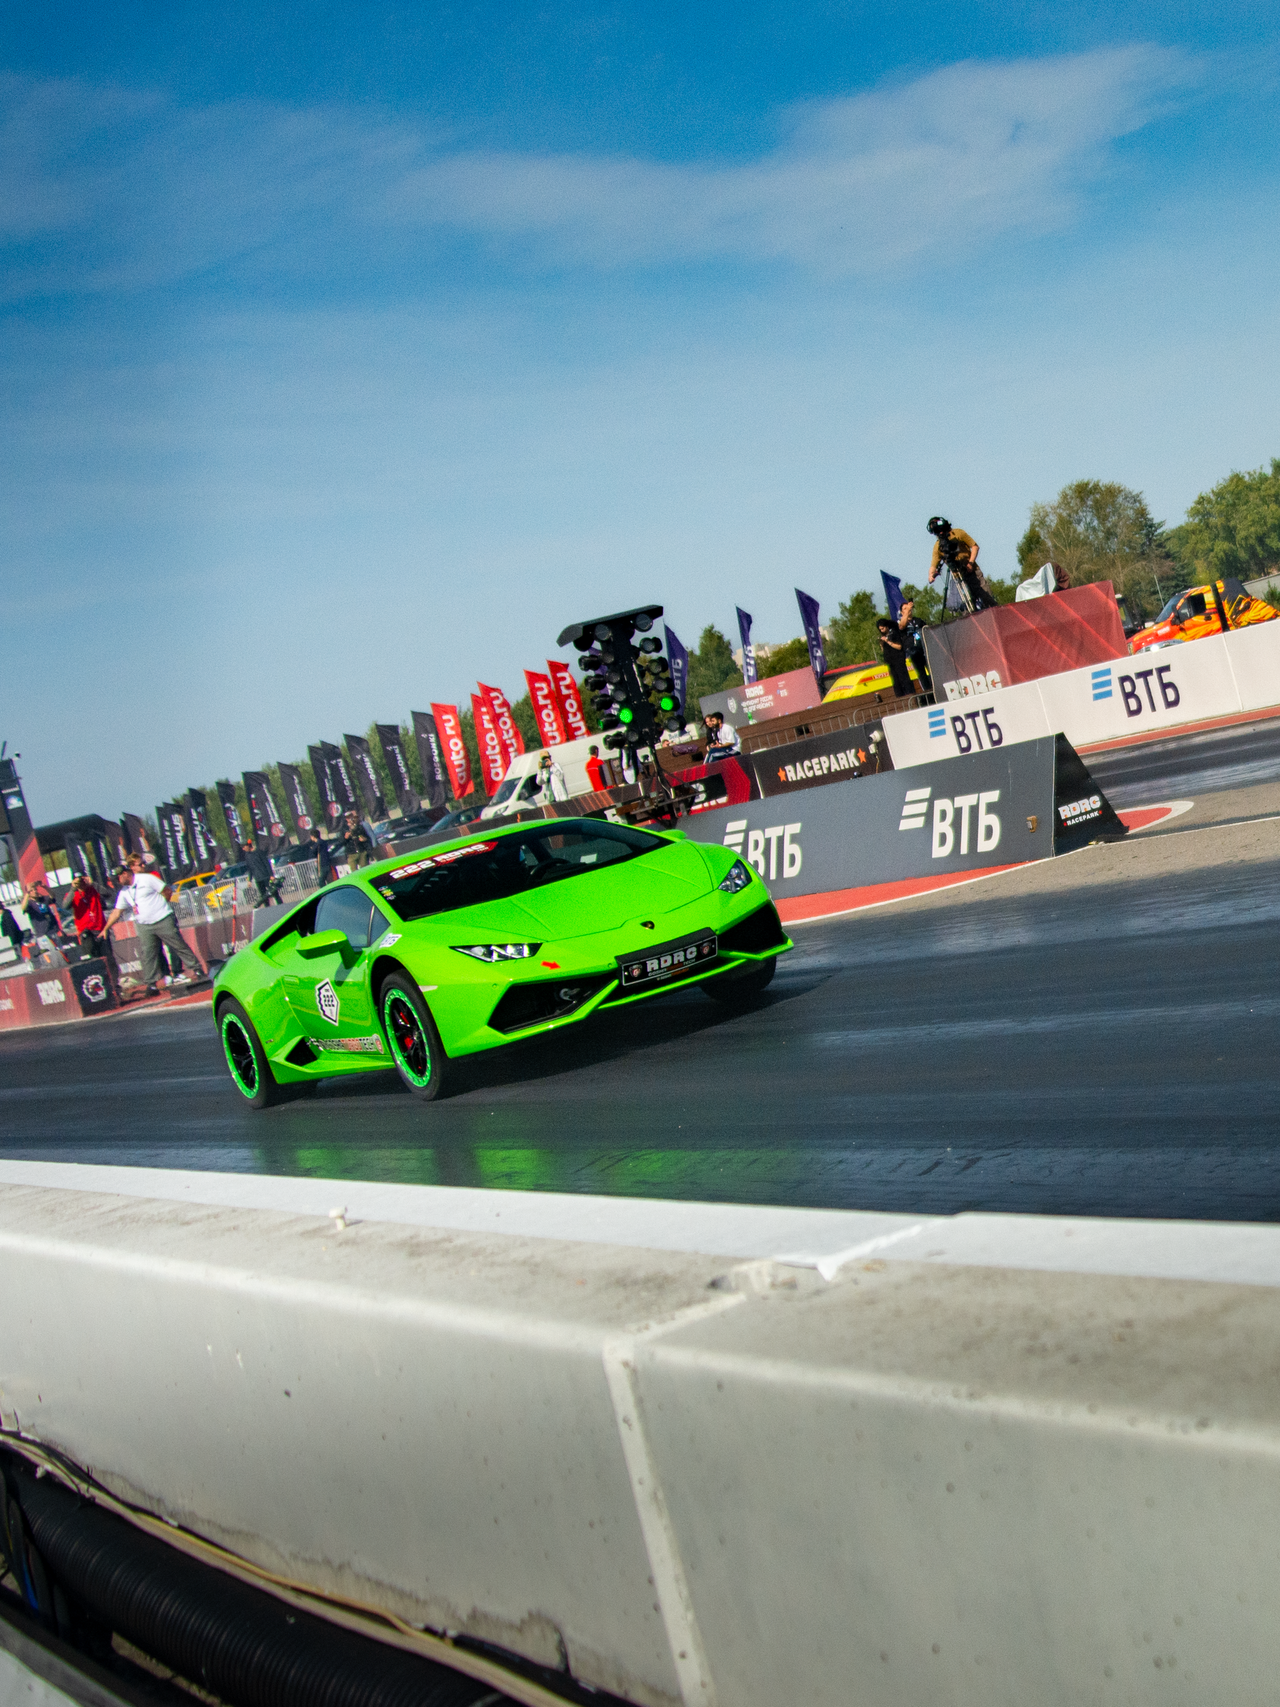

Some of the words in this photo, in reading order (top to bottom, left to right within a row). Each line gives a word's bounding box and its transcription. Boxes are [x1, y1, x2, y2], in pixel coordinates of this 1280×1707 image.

[535, 682, 562, 745] uto.ru
[557, 672, 588, 741] uto.ru
[1118, 664, 1181, 718] ВТБ
[442, 714, 467, 785] auto.ru
[950, 706, 1003, 755] ВТБ
[784, 749, 860, 782] RACEPARK
[932, 790, 1000, 858] ВТБ
[1058, 795, 1101, 820] RDRC
[1067, 810, 1100, 826] RACEPARK
[390, 859, 435, 879] 222
[433, 843, 486, 862] RDRC
[747, 822, 802, 881] ВТБ
[646, 946, 698, 972] RDRC
[323, 994, 335, 1007] 222
